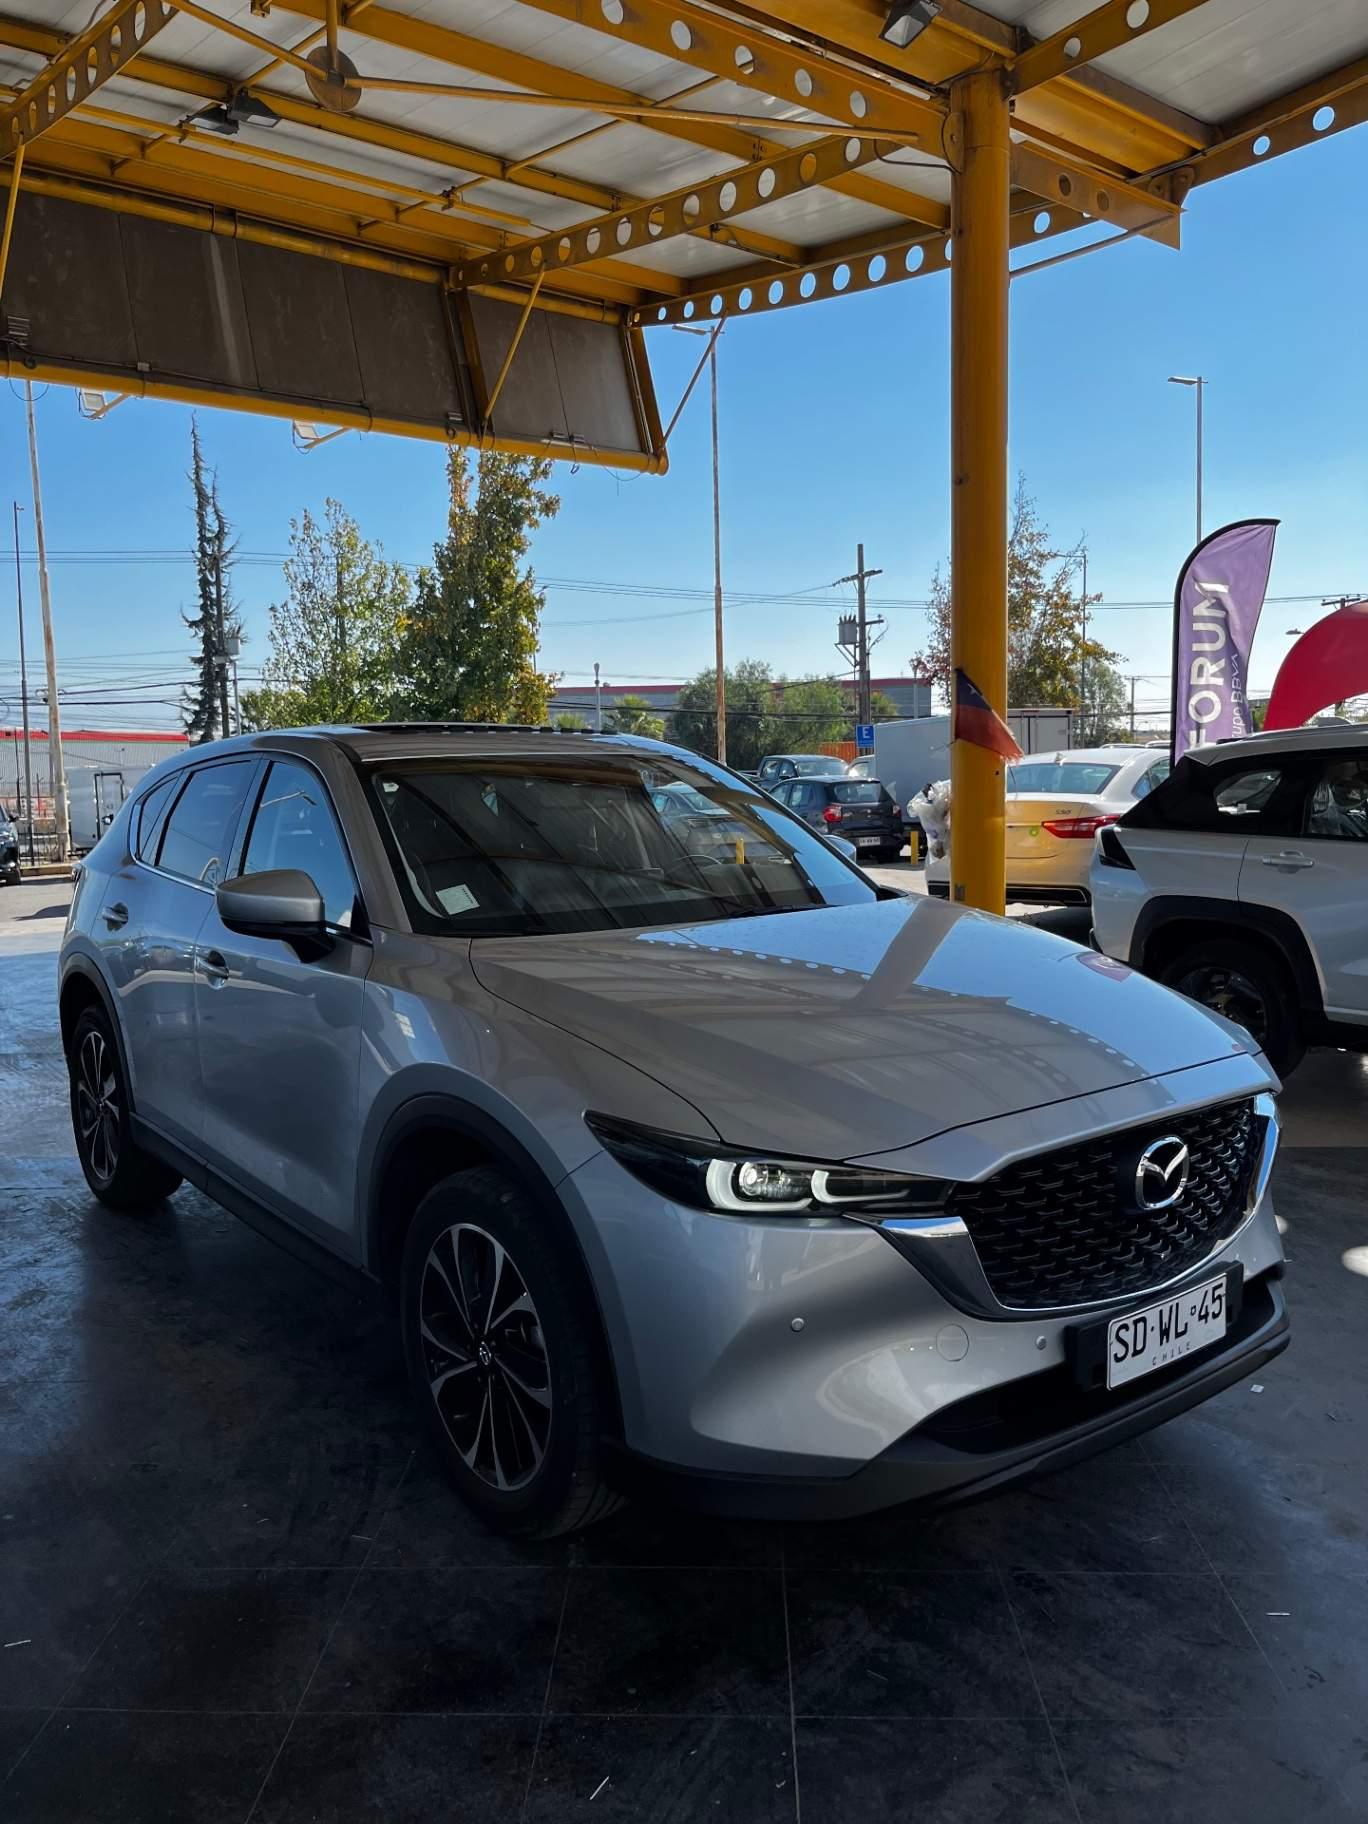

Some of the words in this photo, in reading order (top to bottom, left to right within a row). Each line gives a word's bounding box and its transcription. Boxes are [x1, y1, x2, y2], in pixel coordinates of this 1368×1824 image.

[1188, 581, 1229, 750] FORUM
[1231, 653, 1242, 703] BBVA
[862, 726, 871, 738] E
[1151, 1341, 1191, 1366] CHILE
